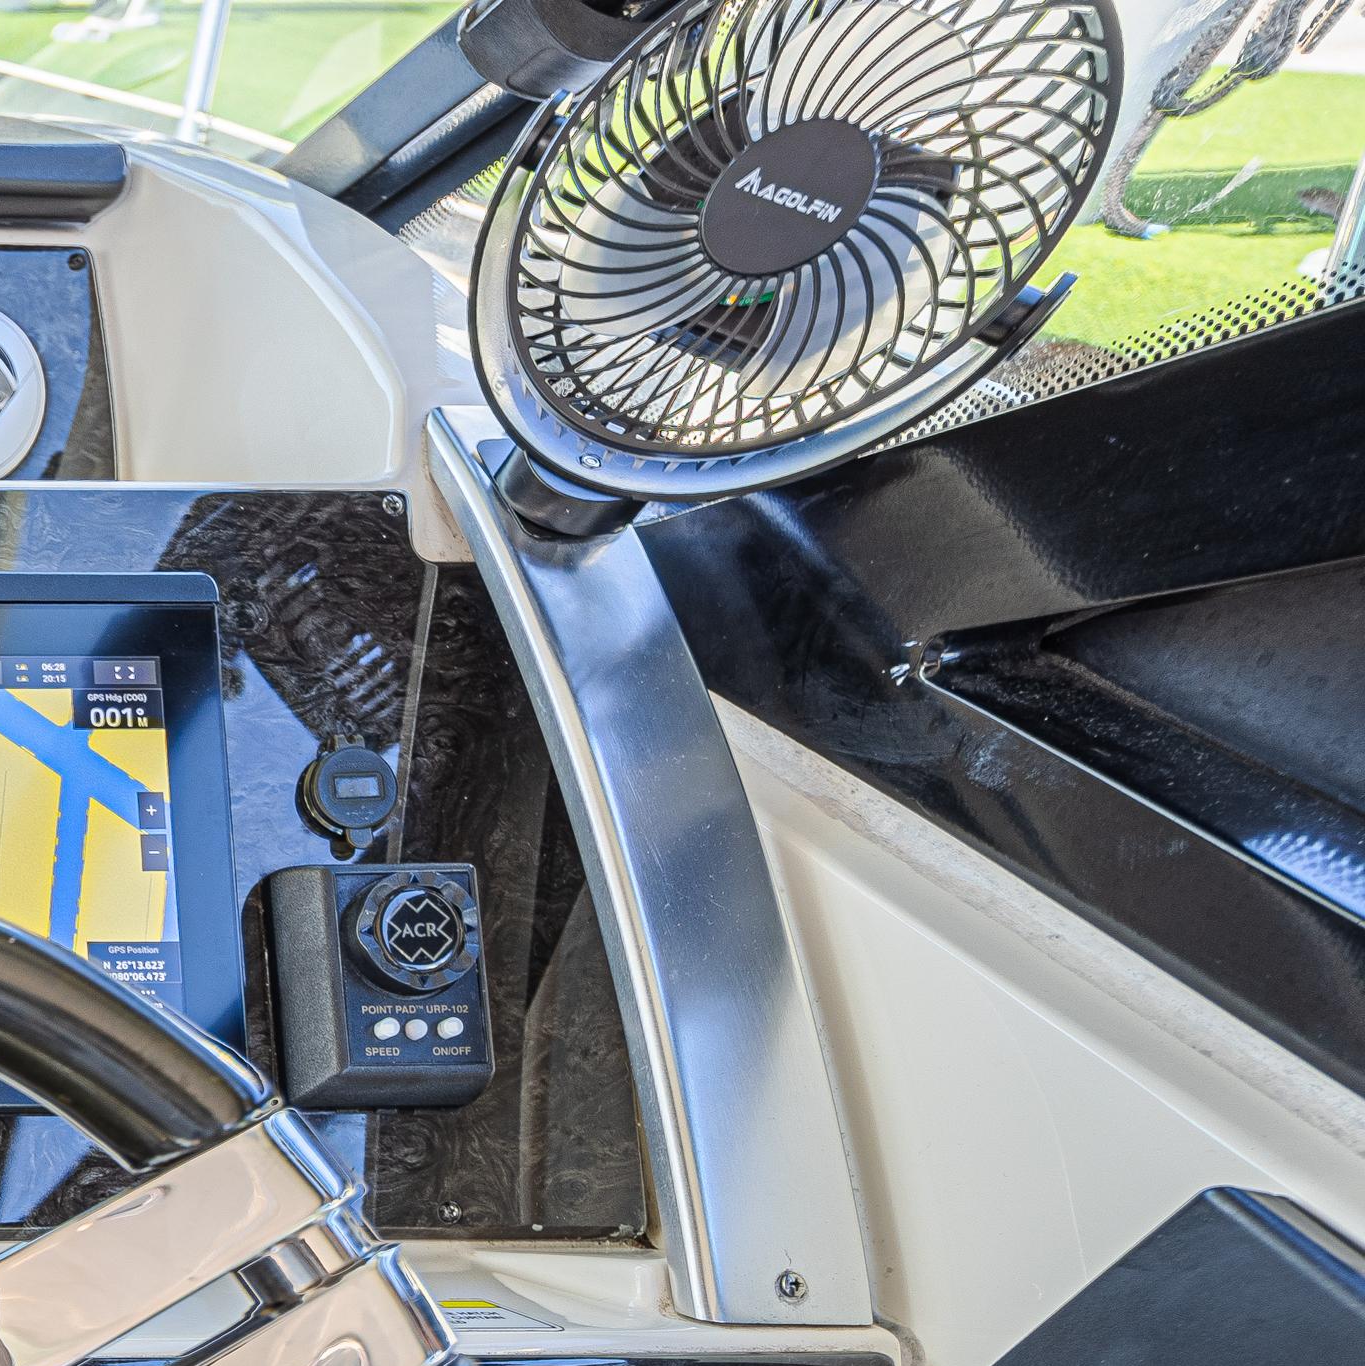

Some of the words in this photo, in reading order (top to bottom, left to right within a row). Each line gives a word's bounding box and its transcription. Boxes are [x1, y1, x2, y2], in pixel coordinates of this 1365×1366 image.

[402, 923, 438, 938] ACR
[108, 946, 126, 954] GPS
[127, 946, 159, 954] Position
[362, 1005, 393, 1014] POINT
[426, 1004, 469, 1014] URP-102
[365, 1047, 400, 1057] SPEED
[432, 1046, 472, 1056] ON/OFF
